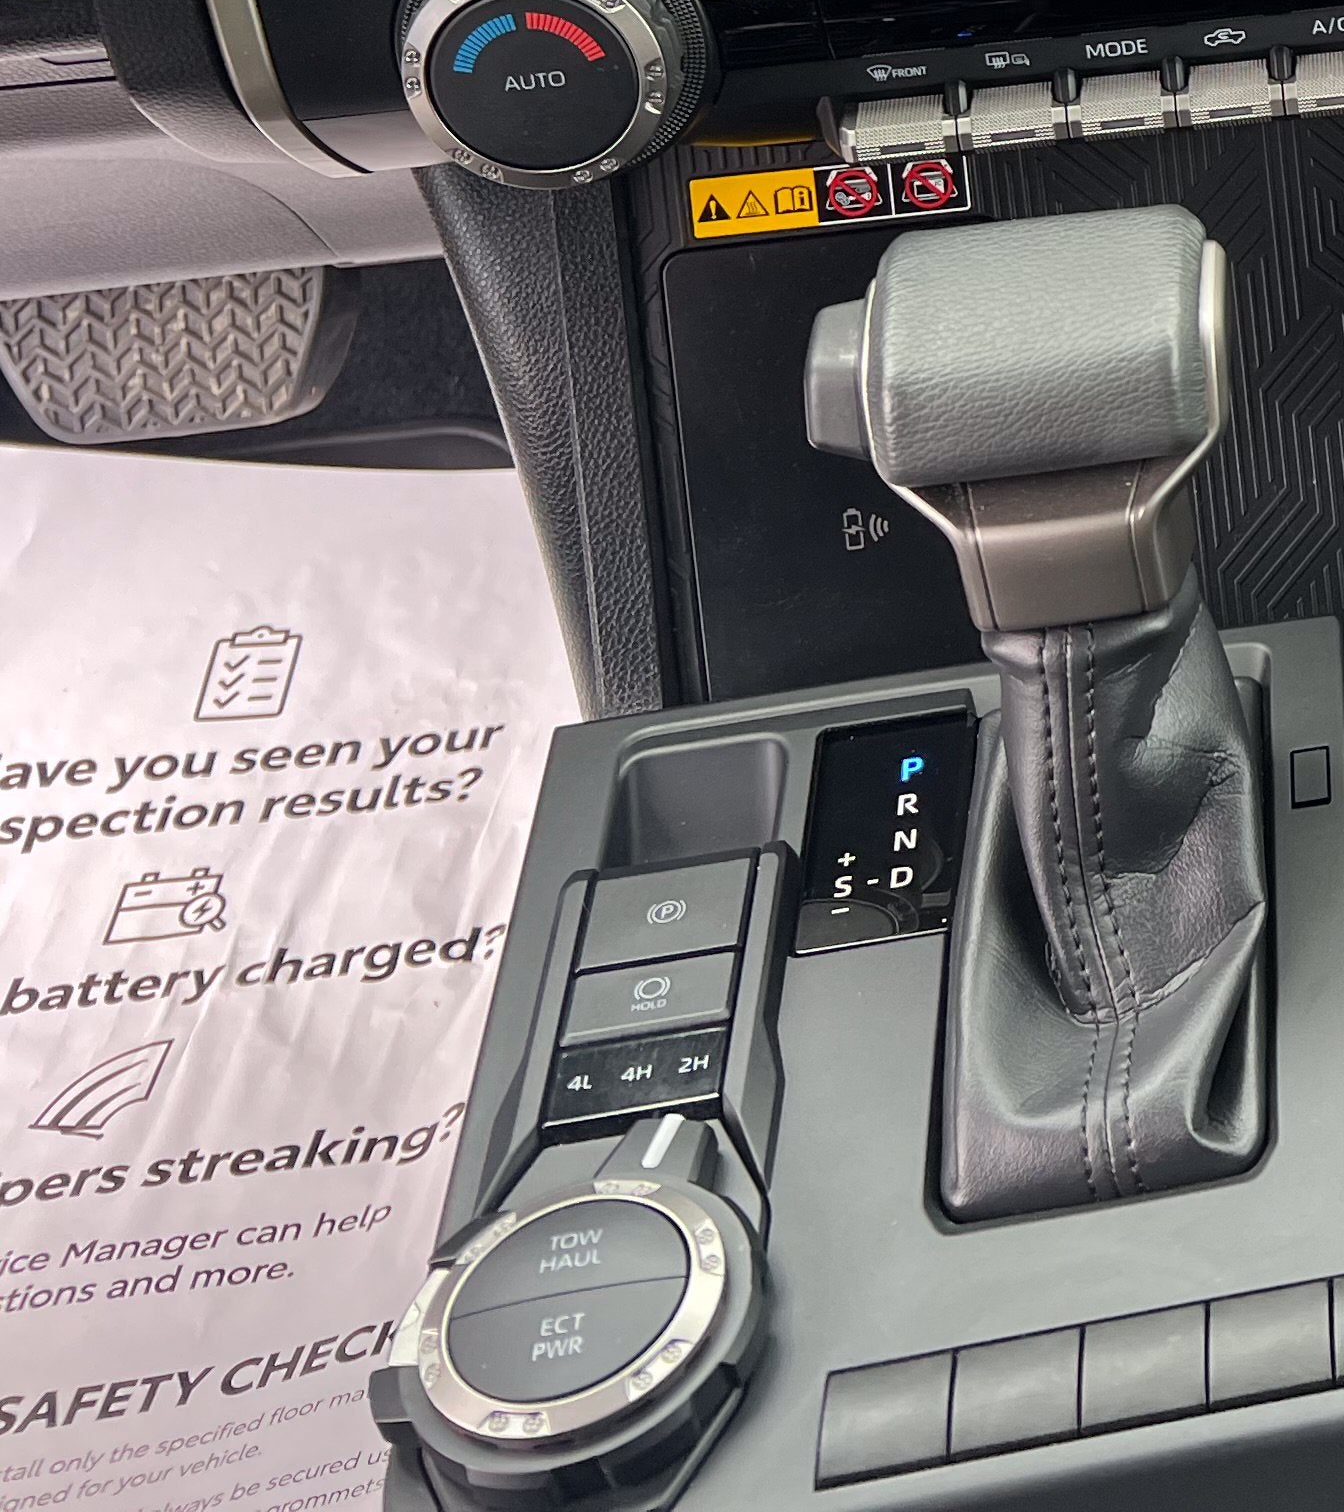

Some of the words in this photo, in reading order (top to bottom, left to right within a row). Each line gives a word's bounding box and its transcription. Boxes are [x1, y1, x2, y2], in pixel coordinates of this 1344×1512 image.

[1085, 38, 1149, 59] MODE
[504, 69, 567, 92] AUTO
[891, 64, 928, 80] FRONT
[0, 753, 97, 790] ave
[105, 749, 217, 794] you
[229, 740, 361, 776] seen
[371, 724, 505, 771] your
[900, 756, 925, 782] P
[258, 767, 483, 824] results?
[897, 792, 919, 816] R
[893, 829, 917, 851] N
[833, 875, 853, 898] S
[889, 864, 914, 889] D
[1, 963, 224, 1017] battery
[235, 924, 506, 986] charged?
[631, 996, 668, 1013] HOLD
[566, 1074, 593, 1093] 4L
[620, 1063, 654, 1084] 4H
[678, 1054, 711, 1075] 2H
[0, 1164, 130, 1208] pers
[140, 1102, 466, 1189] streaking?
[0, 1250, 51, 1277] ice
[59, 1227, 228, 1269] Manager
[235, 1222, 302, 1245] can
[312, 1204, 393, 1239] help
[549, 1228, 603, 1251] TOW
[539, 1248, 603, 1274] HAUL
[0, 1282, 98, 1313] tions
[106, 1265, 183, 1300] and
[190, 1260, 294, 1289] more.
[540, 1311, 586, 1336] ECT
[530, 1334, 584, 1362] PWR
[0, 1365, 215, 1436] SAFETY
